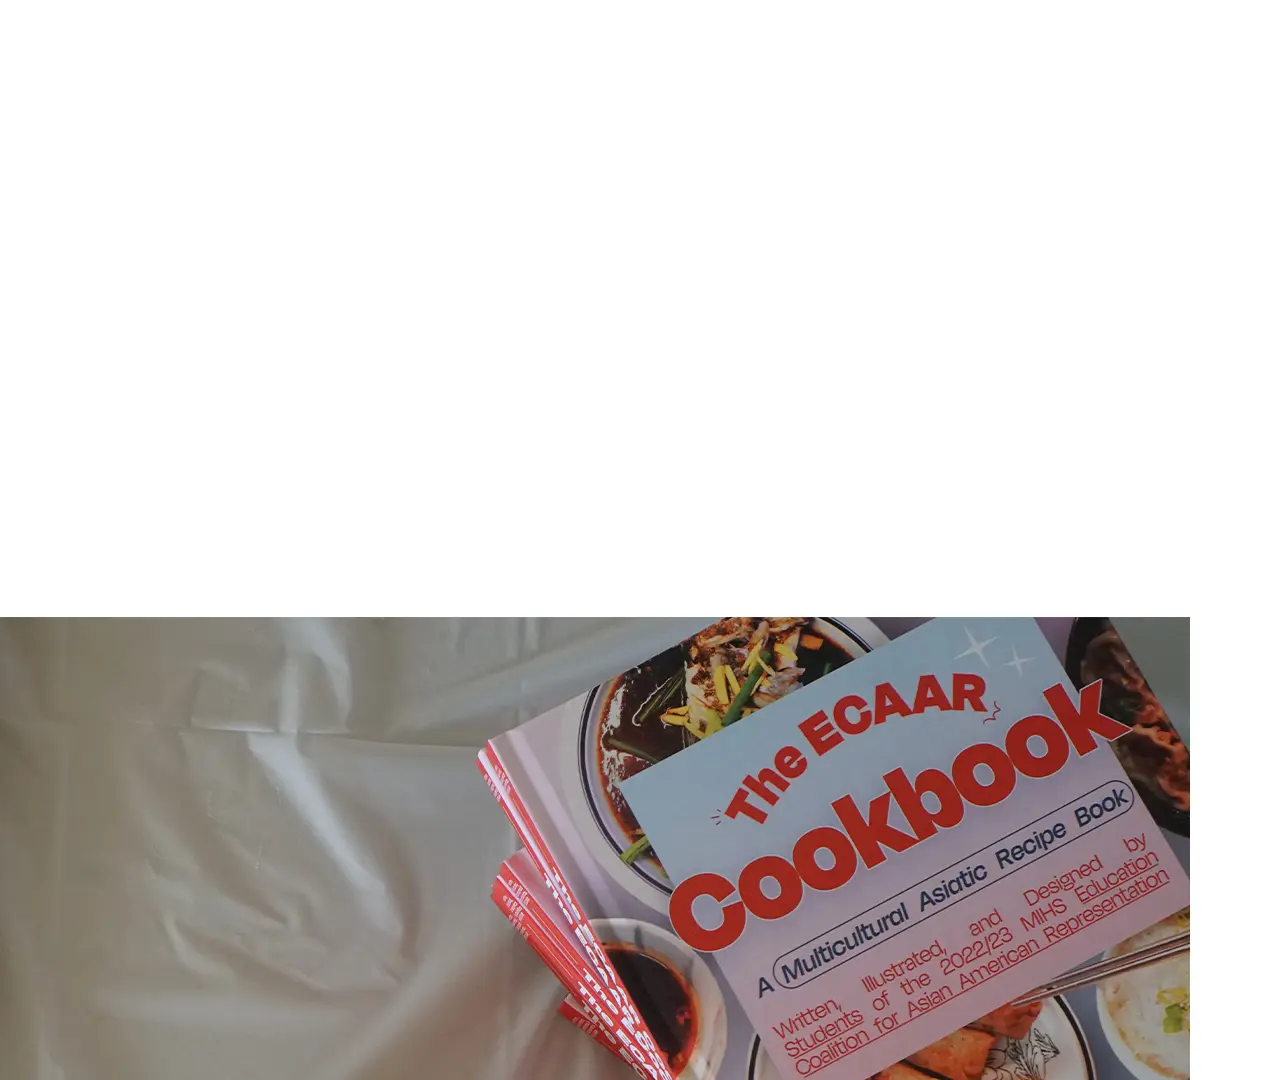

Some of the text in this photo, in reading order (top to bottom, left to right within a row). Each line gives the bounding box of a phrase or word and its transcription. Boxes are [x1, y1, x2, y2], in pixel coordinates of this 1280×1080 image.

[668, 678, 1133, 953] Cookbook
[724, 673, 987, 825] The ECAAR
[583, 968, 618, 1015] The
[758, 788, 1129, 998] A Multicultural Asiatic Recipe Book
[772, 833, 1146, 1039] Written, Illustrated, and Designed by
[784, 851, 1159, 1058] Students of the 2022/23 MIHS Education
[795, 868, 1170, 1076] Coalition for Asian American Representation
[578, 982, 613, 1026] The
